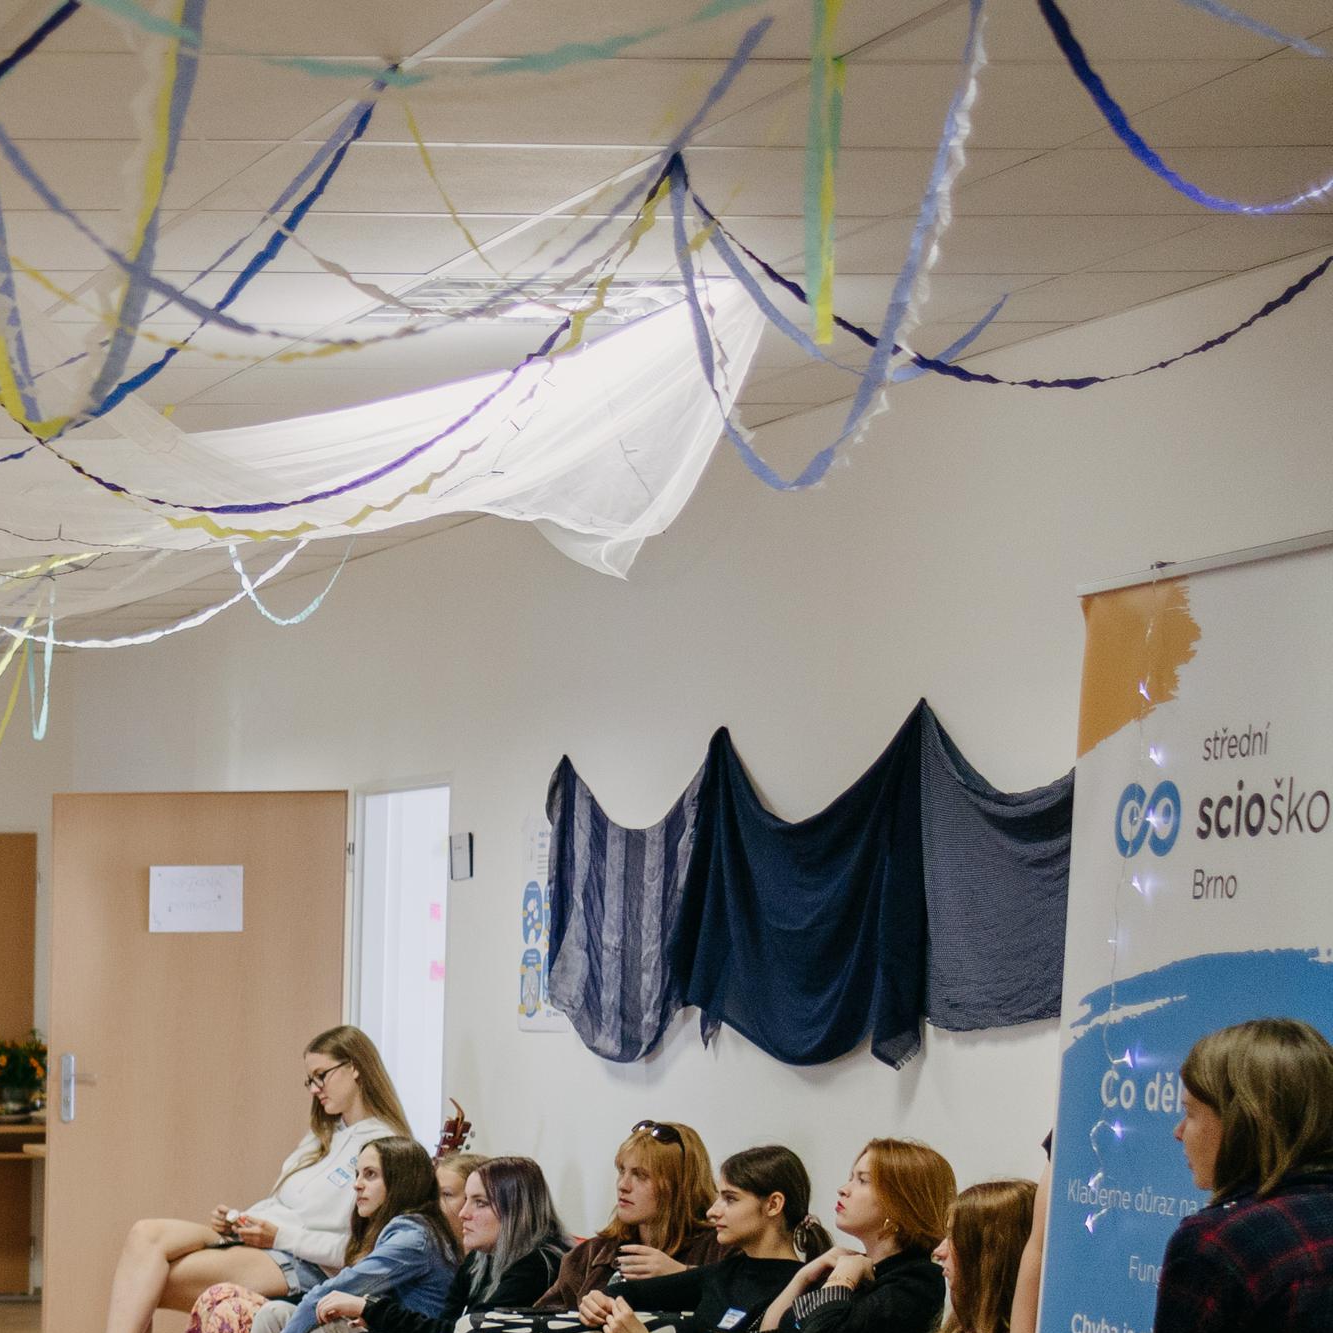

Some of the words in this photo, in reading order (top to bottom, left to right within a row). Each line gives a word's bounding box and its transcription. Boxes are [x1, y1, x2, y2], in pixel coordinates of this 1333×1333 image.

[1202, 721, 1271, 761] střední
[1192, 868, 1238, 900] Brno
[1100, 1069, 1136, 1109] Co
[1067, 1178, 1131, 1210] Klademe
[1134, 1186, 1175, 1216] důraz
